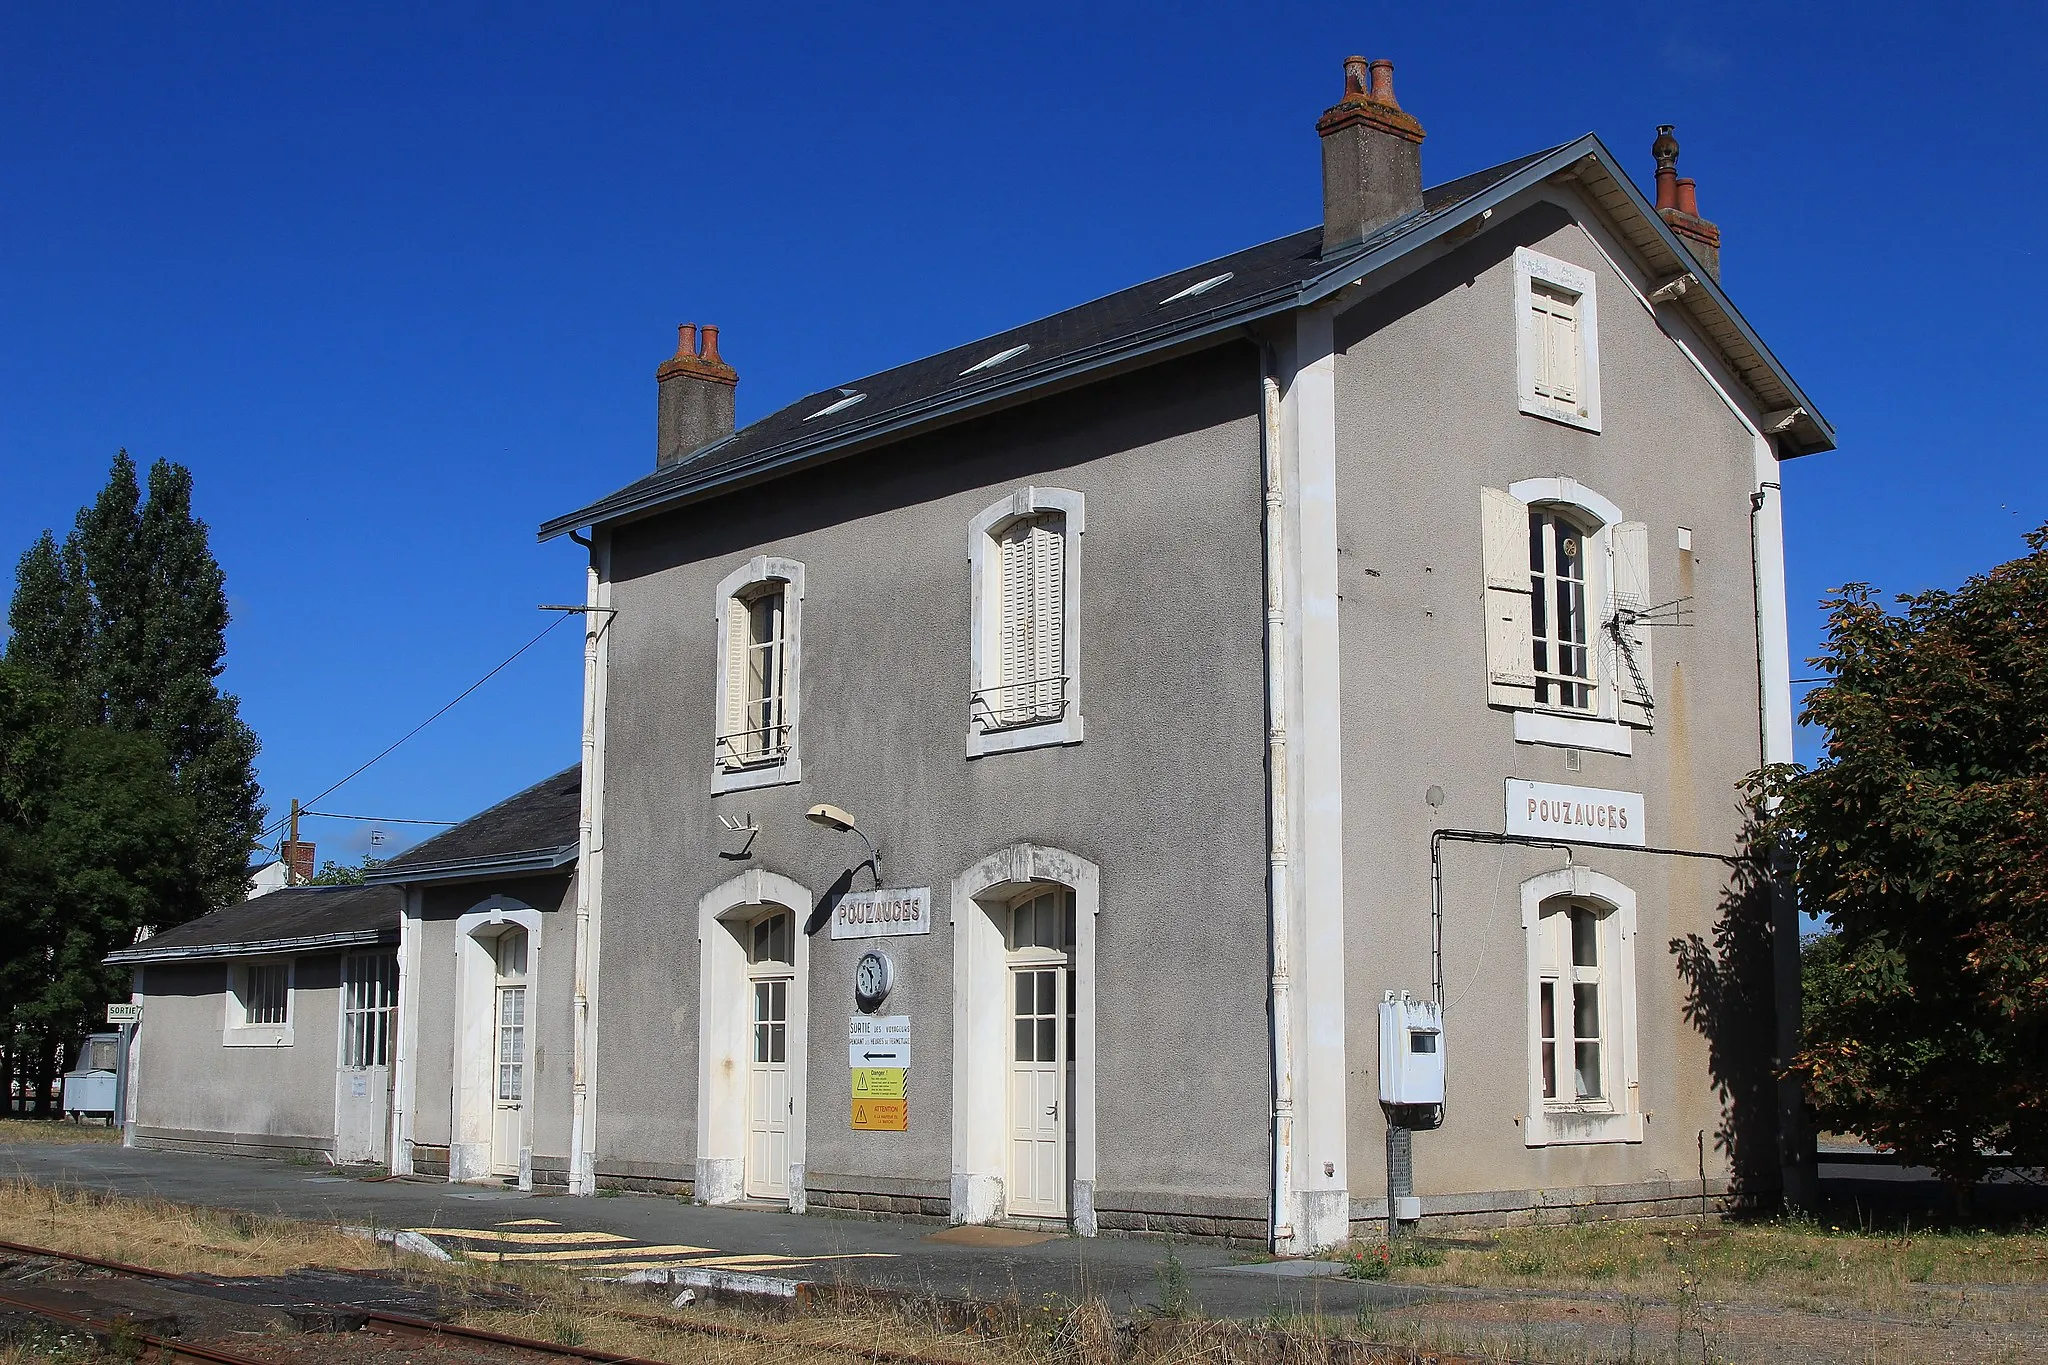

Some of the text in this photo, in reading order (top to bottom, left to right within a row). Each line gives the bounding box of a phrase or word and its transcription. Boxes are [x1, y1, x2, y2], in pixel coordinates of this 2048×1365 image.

[110, 1006, 136, 1014] SORTIE
[849, 1022, 910, 1034] SORTIE DES VOYAGEURS
[870, 1069, 885, 1077] Danger
[874, 1105, 899, 1113] ATTENTION
